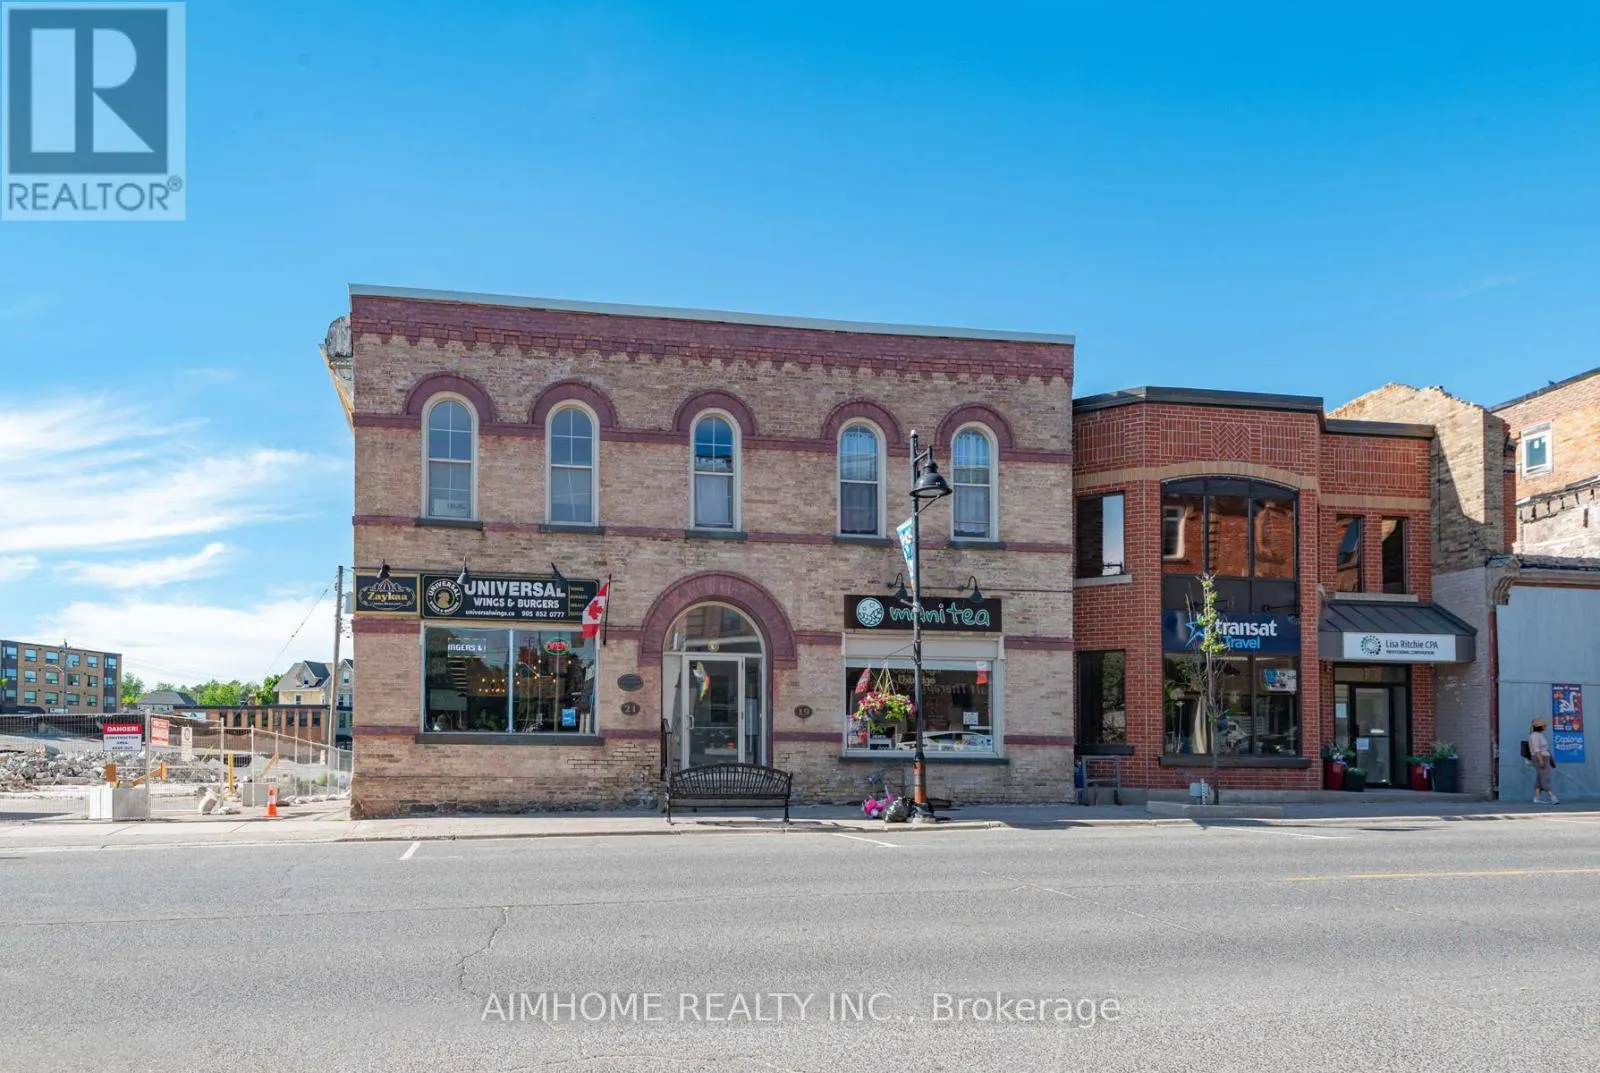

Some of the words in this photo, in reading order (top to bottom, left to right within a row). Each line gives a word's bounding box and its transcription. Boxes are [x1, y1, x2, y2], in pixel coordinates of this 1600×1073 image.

[428, 581, 460, 597] UNIVERSAL
[464, 580, 566, 598] UNIVERSAL
[474, 598, 505, 607] WINGS
[508, 598, 516, 607] &
[518, 598, 560, 608] BURGERS
[1215, 618, 1278, 636] transat
[1224, 636, 1260, 648] Travel
[1386, 640, 1398, 648] Lisa
[1400, 640, 1424, 648] Ritchie
[1425, 640, 1438, 648] CPA
